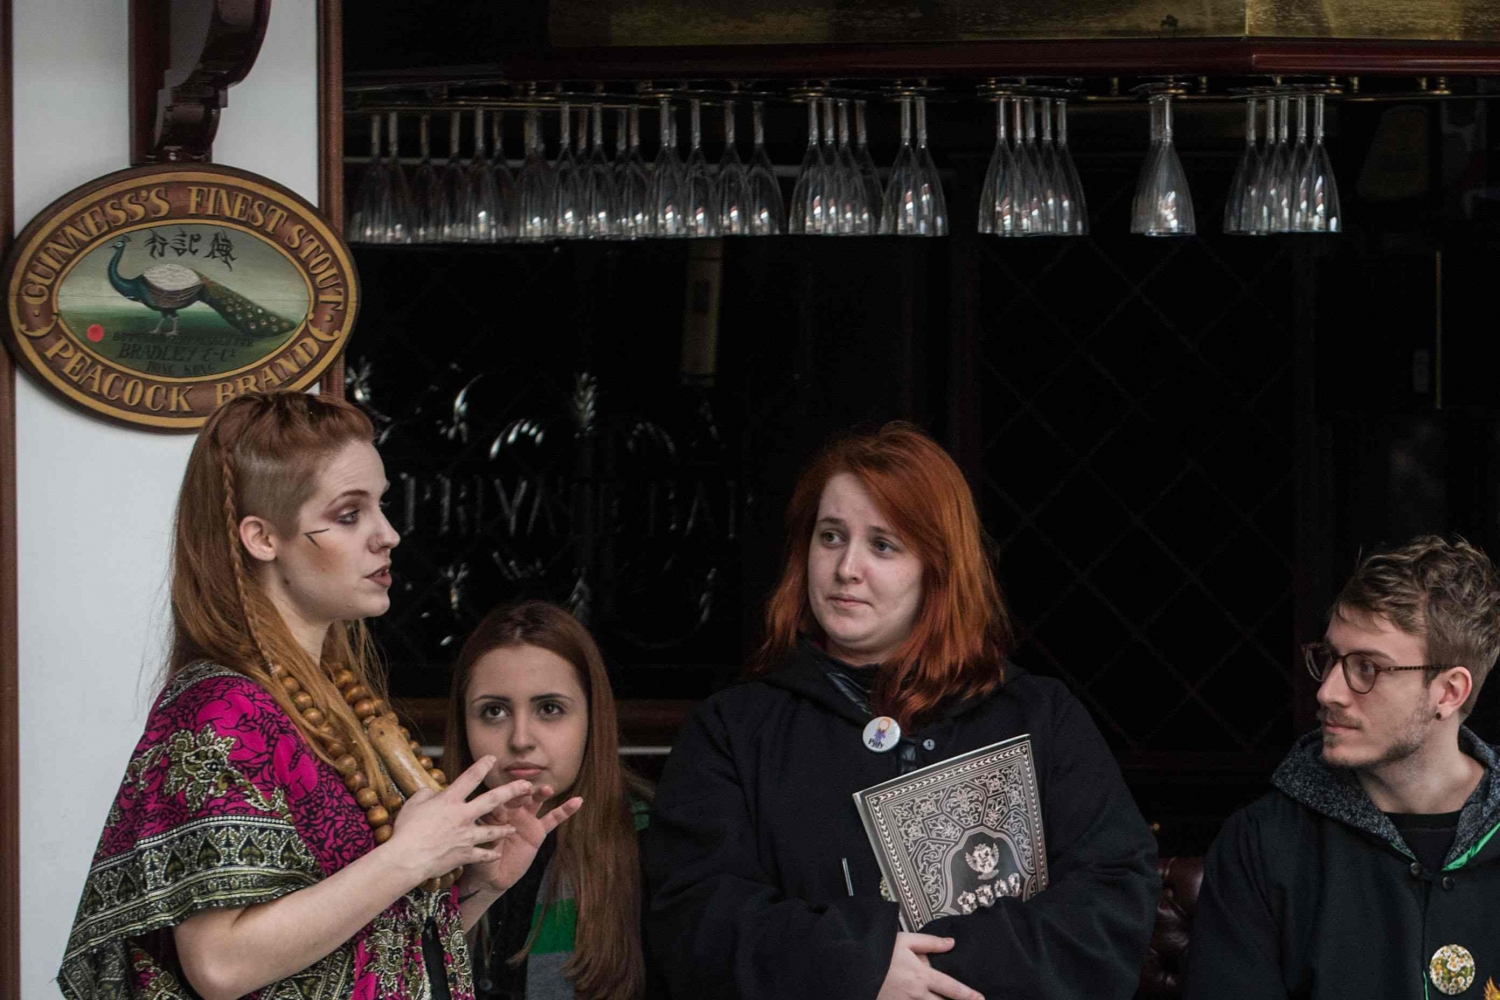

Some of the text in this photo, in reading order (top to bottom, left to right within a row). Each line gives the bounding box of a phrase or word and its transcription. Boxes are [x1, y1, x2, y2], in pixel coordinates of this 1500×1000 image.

[22, 185, 345, 313] GUINNESS'S FINEST STOUT
[47, 334, 319, 413] PEACOCK BRAND
